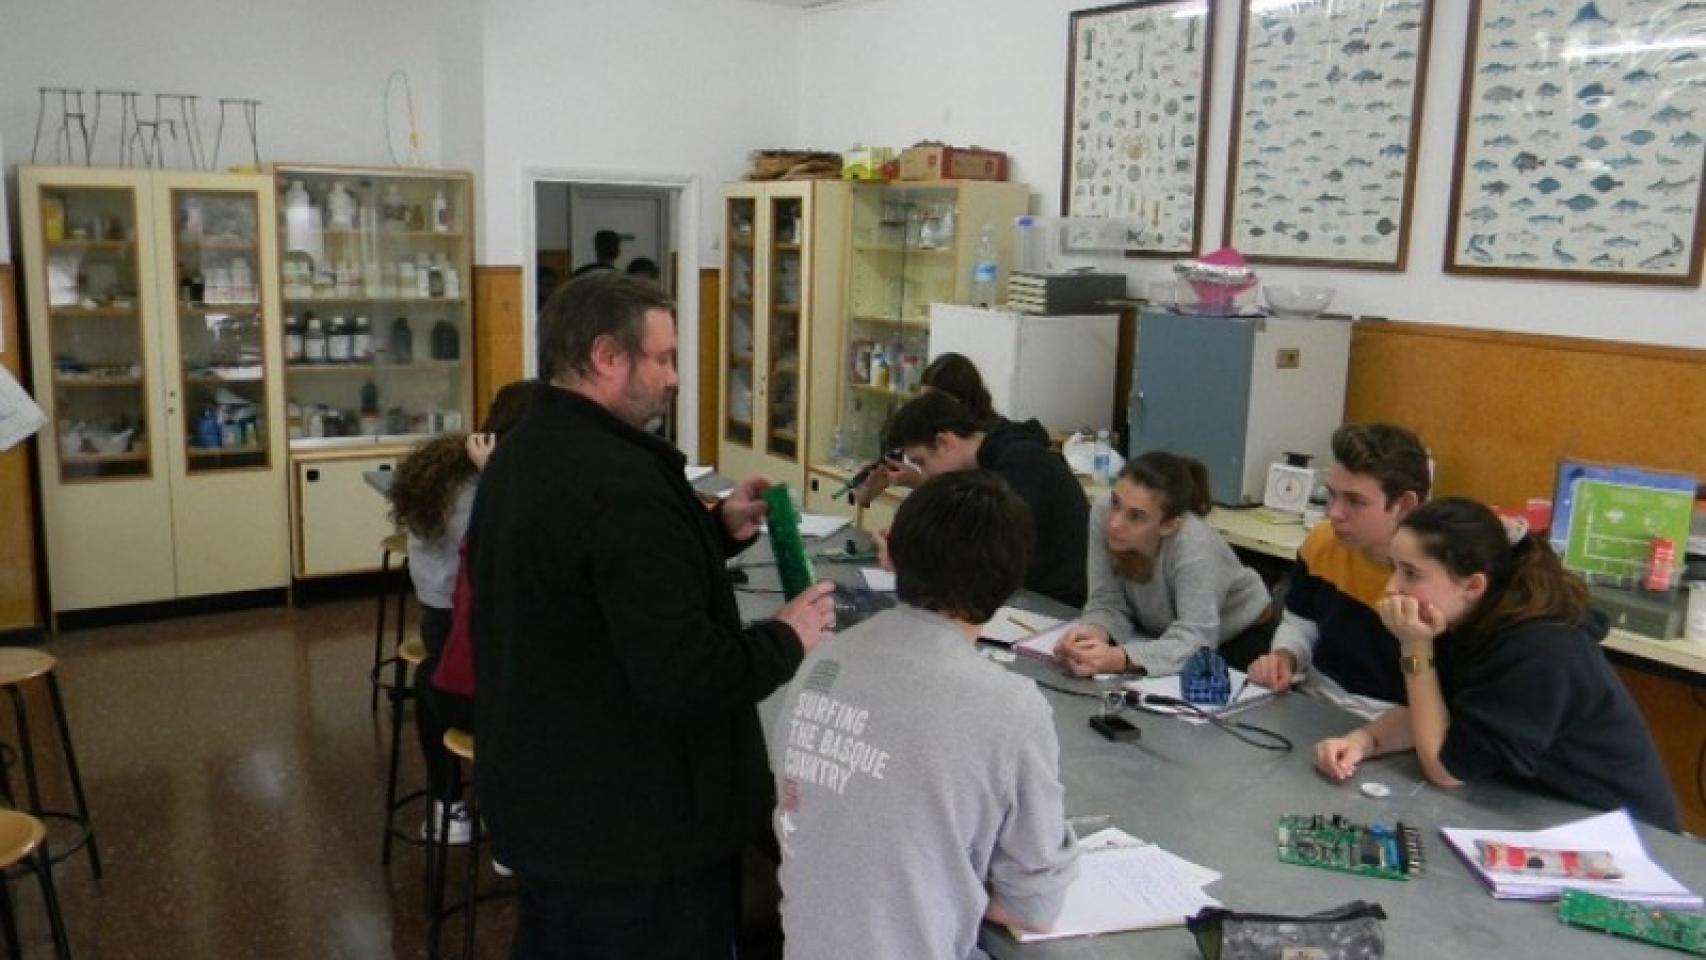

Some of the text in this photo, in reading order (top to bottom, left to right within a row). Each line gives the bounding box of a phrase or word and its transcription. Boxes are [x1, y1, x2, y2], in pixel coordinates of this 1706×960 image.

[793, 693, 869, 735] SURFING
[784, 746, 853, 795] COUNTRY
[786, 719, 890, 780] THE BASQUE
